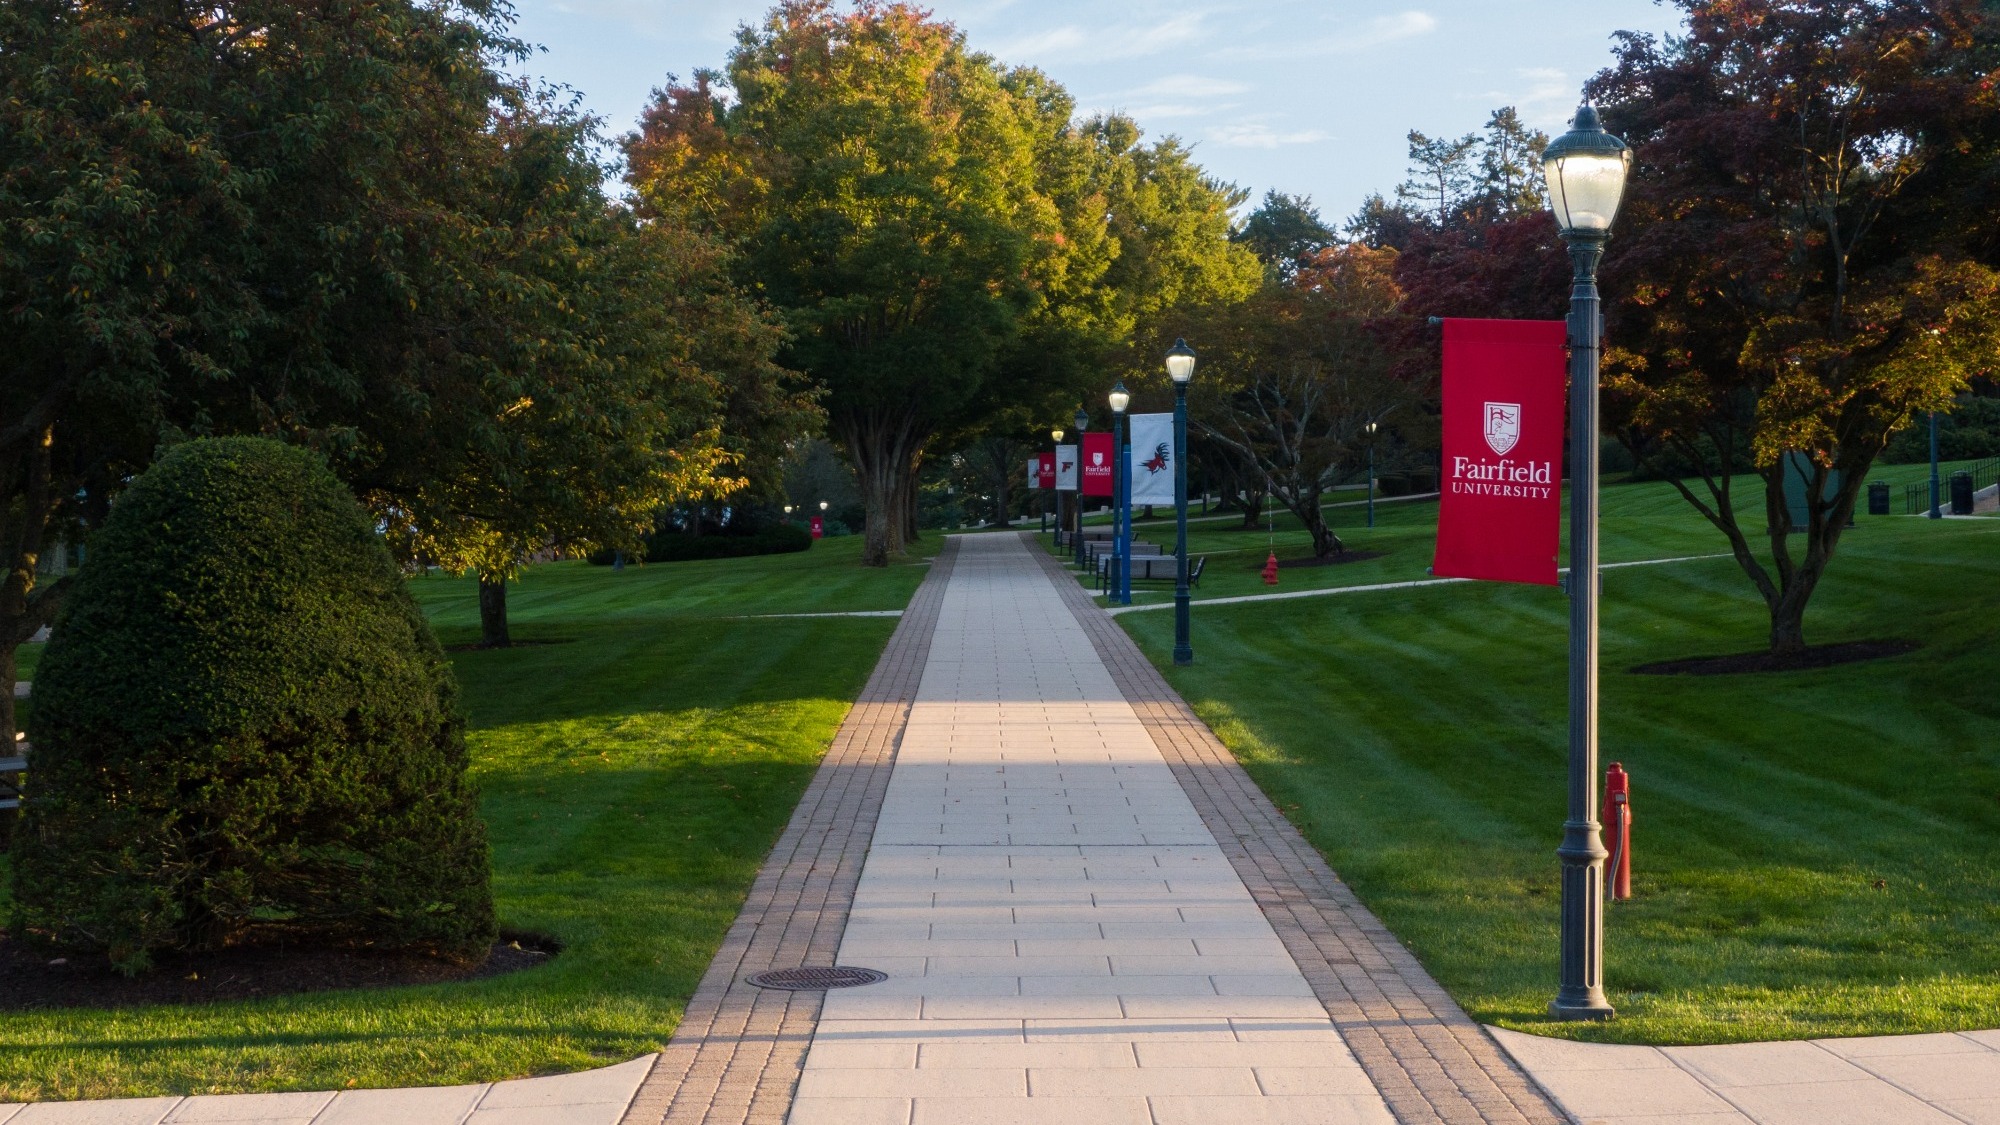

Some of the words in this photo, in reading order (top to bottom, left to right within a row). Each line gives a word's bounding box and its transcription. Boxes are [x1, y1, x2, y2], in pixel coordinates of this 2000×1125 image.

[1085, 465, 1110, 473] Fairfield
[1452, 456, 1551, 484] Fairfield
[1452, 482, 1551, 499] UNIVERSITY
